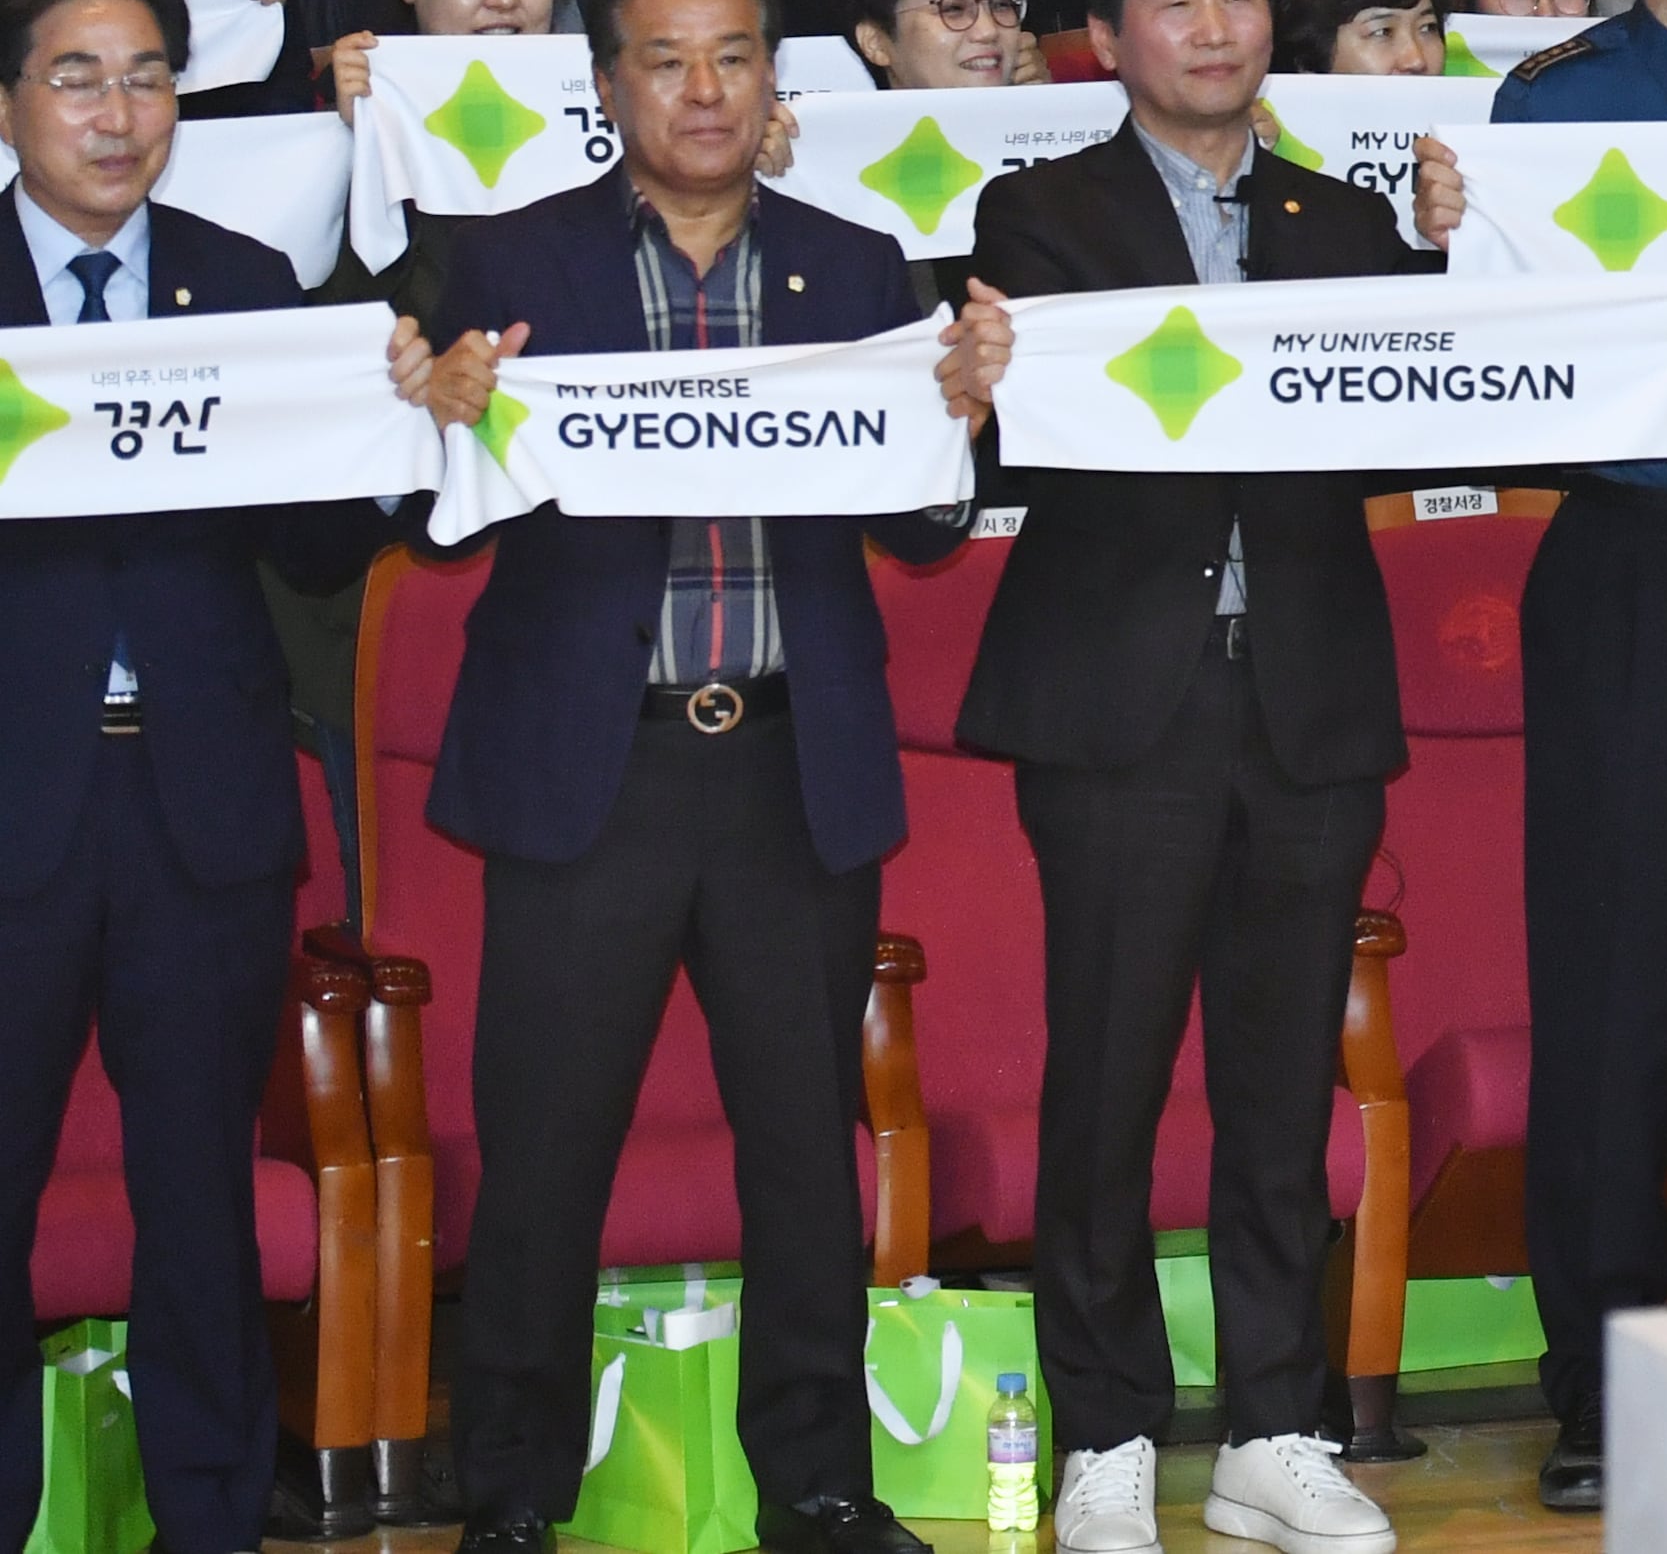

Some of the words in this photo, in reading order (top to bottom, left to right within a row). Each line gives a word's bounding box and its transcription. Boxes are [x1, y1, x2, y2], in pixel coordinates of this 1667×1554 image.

[1273, 334, 1314, 352] MY
[1321, 332, 1455, 352] UNIVERSE
[556, 384, 597, 398] MY
[606, 378, 750, 398] UNIVERSE
[1270, 365, 1574, 403] GYEONGSAN
[94, 397, 220, 459] 경산
[559, 410, 885, 449] GYEONGSAN
[1425, 494, 1485, 516] 경찰서장
